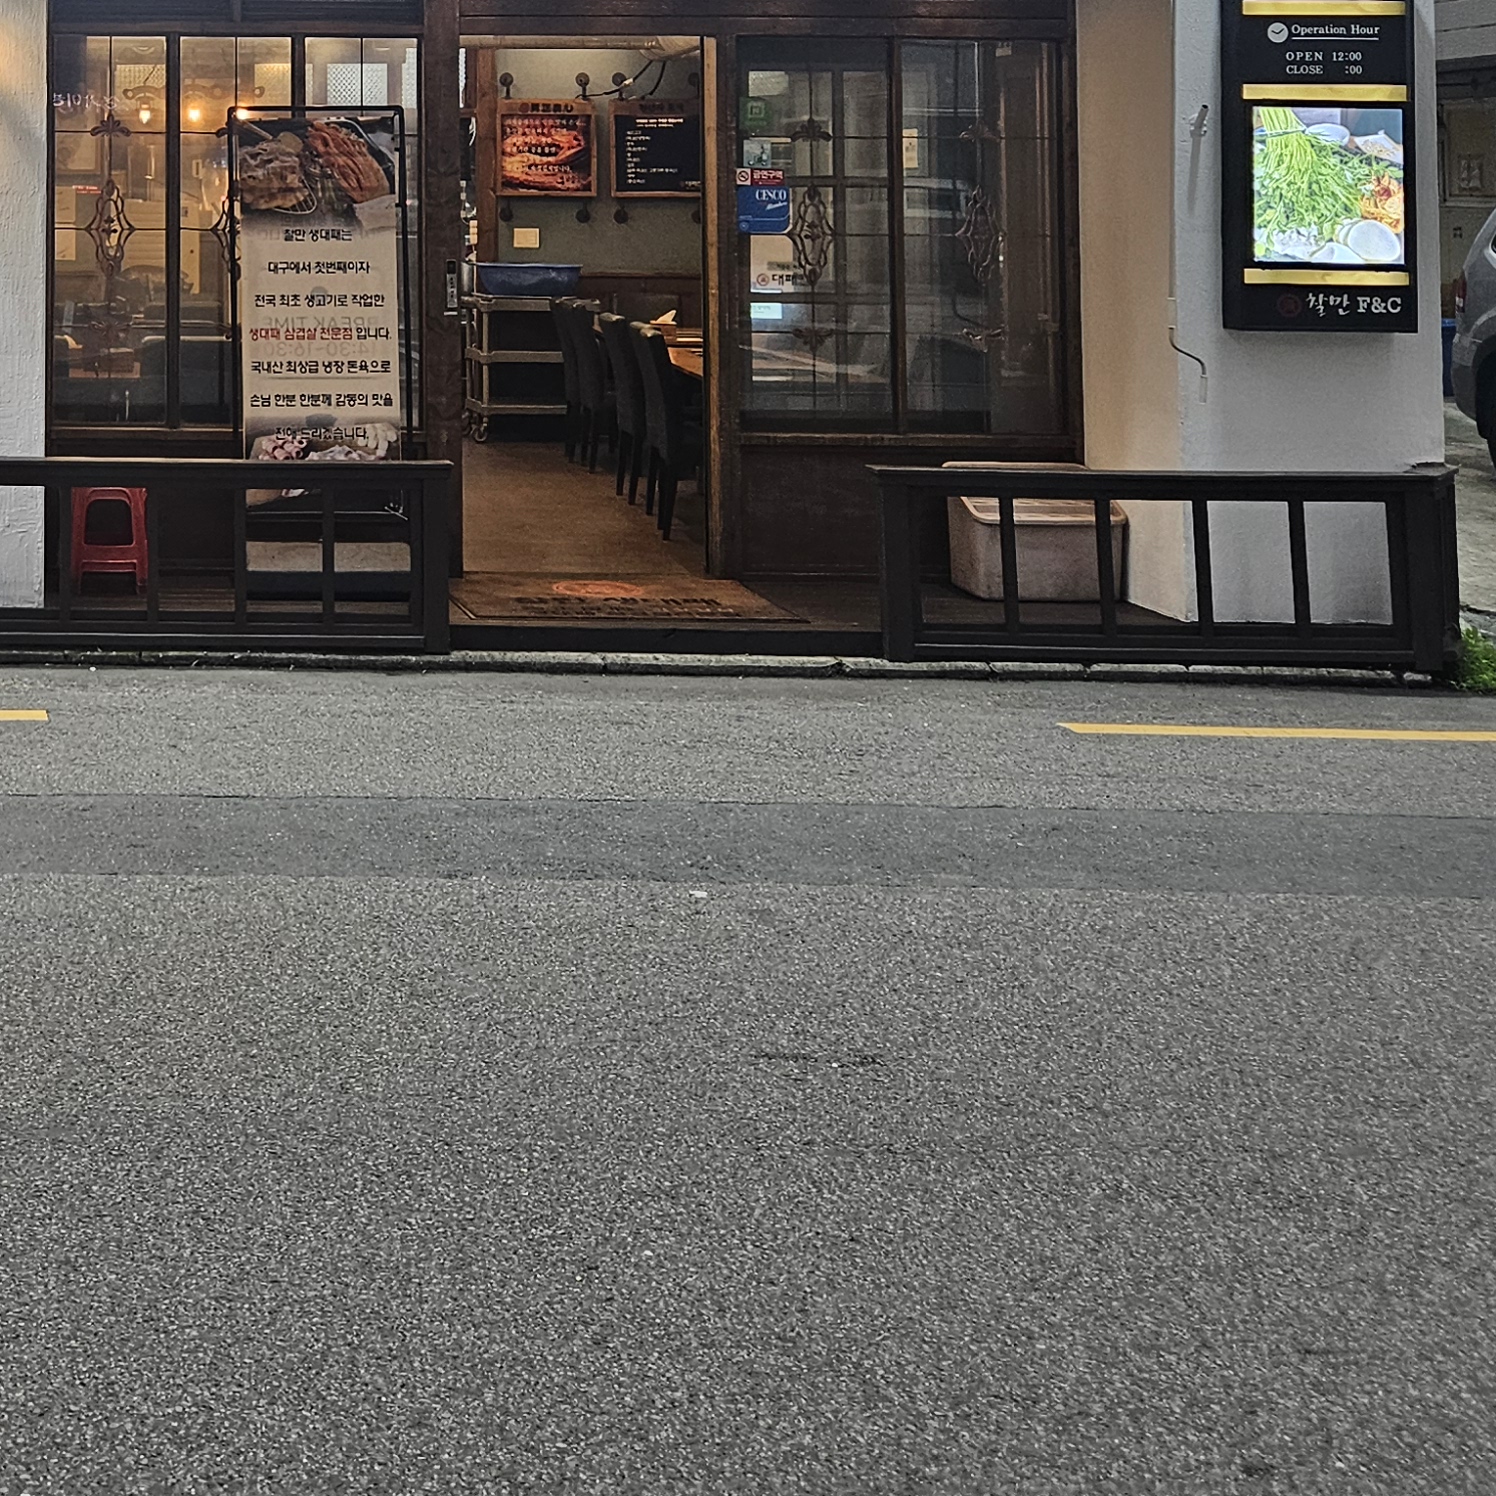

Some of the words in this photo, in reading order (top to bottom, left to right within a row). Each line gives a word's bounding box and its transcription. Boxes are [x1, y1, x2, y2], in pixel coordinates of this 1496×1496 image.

[1291, 24, 1347, 36] Operation
[1350, 24, 1380, 35] Hour
[1285, 51, 1324, 62] OPEN
[1332, 51, 1363, 62] 12:00
[1285, 65, 1324, 74] CLOSE
[283, 228, 306, 242] 찰만
[308, 228, 353, 242] 생대패는
[267, 261, 311, 274] 대구에서
[314, 261, 370, 274] 첫번째이자
[254, 294, 276, 307] 전국
[279, 294, 301, 307] 최초
[304, 294, 349, 308] 생고기로
[351, 293, 386, 307] 작업한
[1356, 296, 1402, 313] F&C
[249, 327, 281, 341] 생대패
[284, 327, 317, 340] 삼겹살
[320, 327, 353, 340] 전문점
[356, 326, 392, 340] 입니다.
[251, 360, 284, 374] 국내산
[286, 360, 319, 374] 최상급
[322, 360, 345, 374] 냉장
[347, 360, 392, 374] 돈육으로
[250, 393, 271, 407] 손님
[274, 393, 297, 407] 한분
[335, 393, 369, 407] 감동의
[372, 392, 393, 407] 맛을
